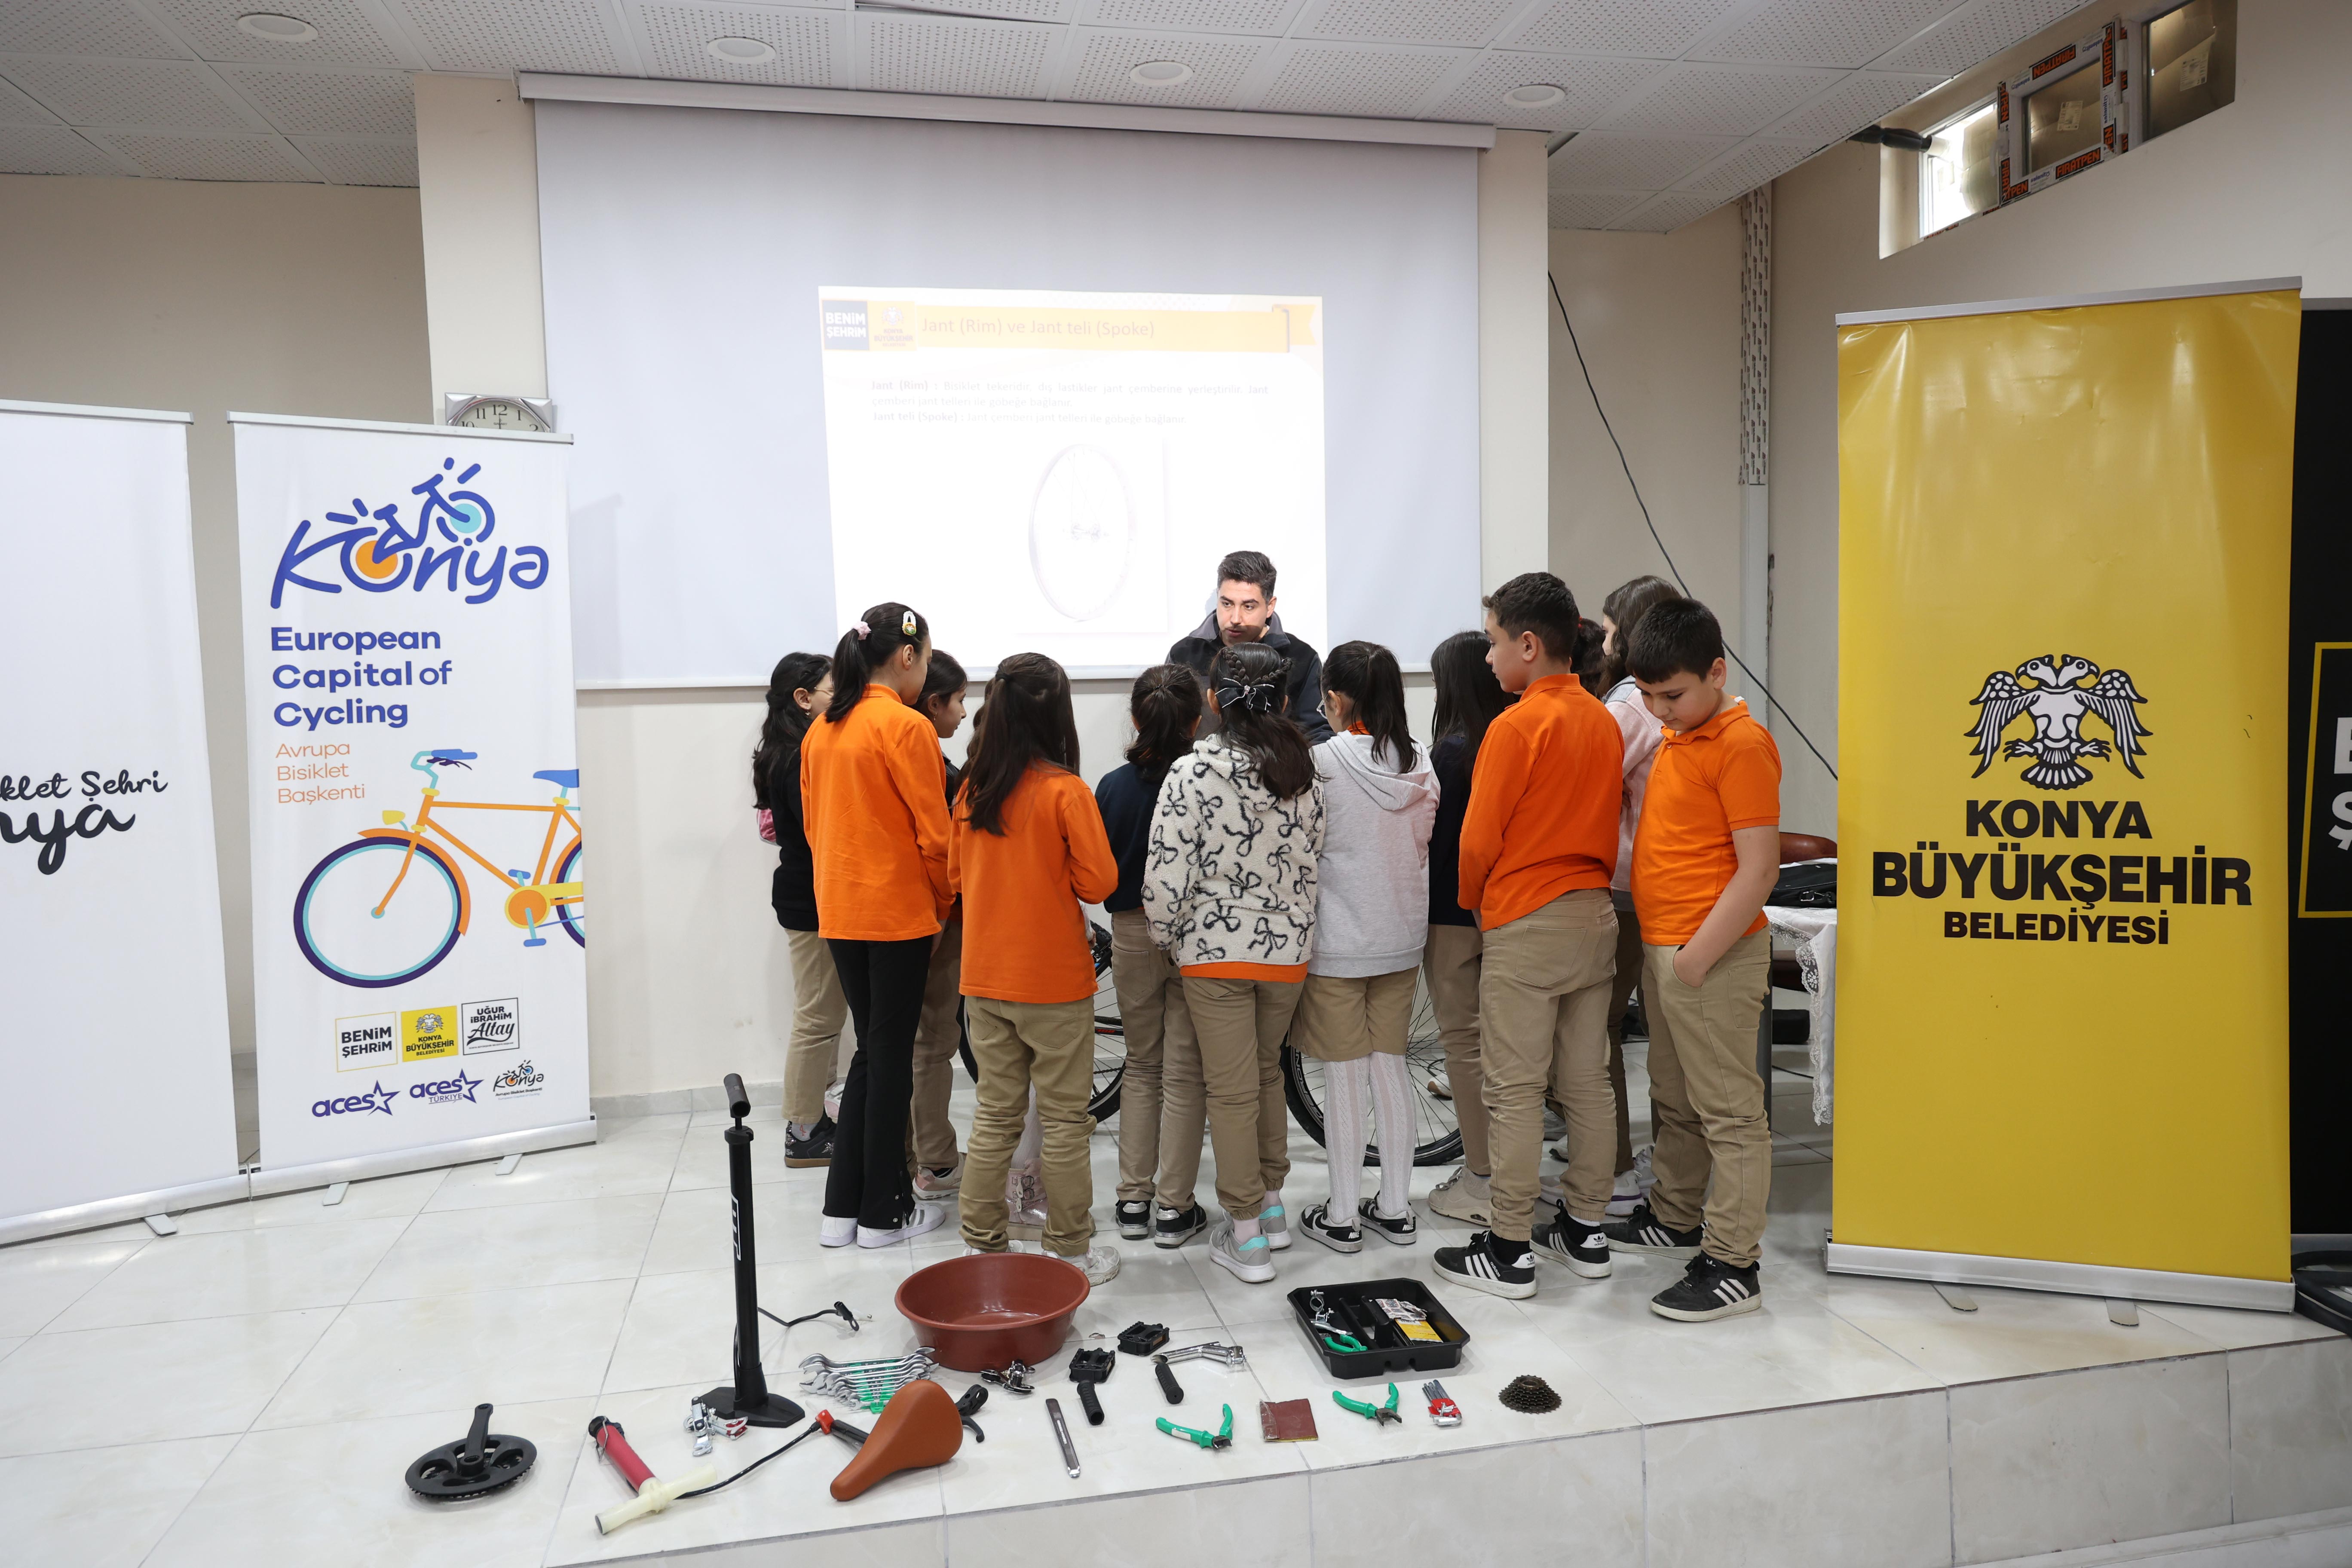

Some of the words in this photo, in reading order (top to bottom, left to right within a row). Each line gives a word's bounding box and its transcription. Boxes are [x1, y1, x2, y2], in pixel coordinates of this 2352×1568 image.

[2056, 149, 2101, 179] FIRATPEN
[922, 318, 955, 333] Jant
[960, 317, 1002, 337] (Rim)
[1007, 322, 1026, 334] ve
[1030, 320, 1062, 334] Jant
[1067, 321, 1091, 335] teli
[1097, 321, 1155, 339] (Spoke)
[476, 408, 486, 420] 11
[493, 404, 507, 416] 12
[517, 410, 521, 421] 1
[271, 627, 441, 655] European
[273, 661, 412, 693] Capital
[419, 660, 453, 685] of
[274, 698, 408, 732] Cycling
[276, 742, 350, 760] Avrupa
[277, 763, 349, 781] Bisiklet
[278, 784, 365, 806] Başkenti
[1966, 799, 2153, 839] KONYA
[1872, 841, 2253, 910] BÜYÜKŞEHİR
[1944, 907, 2169, 945] BELEDİYESİ
[477, 1006, 505, 1015] UĞUR
[418, 1035, 442, 1043] KONYA
[467, 1022, 515, 1046] Altay
[406, 1039, 454, 1052] BÜYÜKŞEHİR
[416, 1048, 445, 1056] BELEDİYESİ
[409, 1078, 463, 1099] aces
[312, 1093, 375, 1118] aces
[1490, 1261, 1501, 1277] adidas
